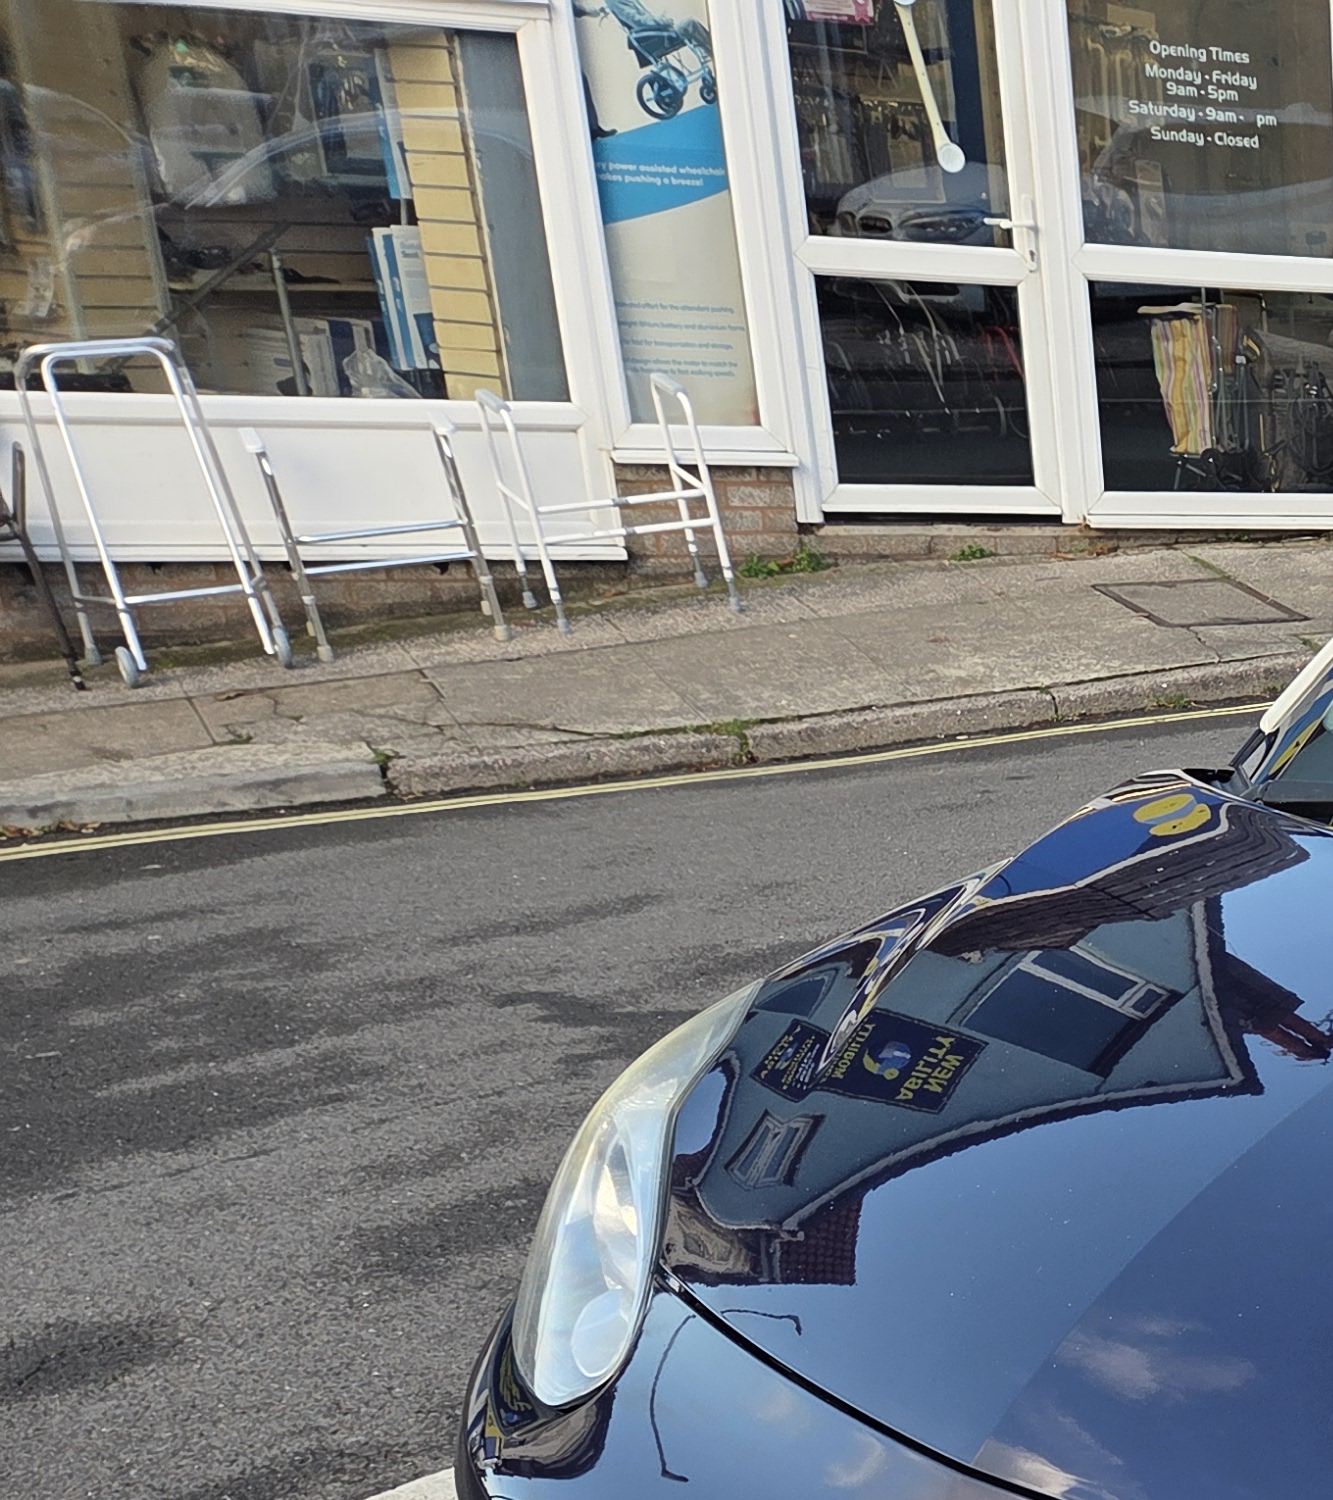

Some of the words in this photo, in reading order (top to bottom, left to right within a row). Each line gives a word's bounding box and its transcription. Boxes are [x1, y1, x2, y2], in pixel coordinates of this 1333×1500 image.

[1150, 40, 1206, 62] Opening
[1209, 47, 1250, 63] Times
[1145, 64, 1201, 84] Monday
[1212, 70, 1257, 90] Friday
[1166, 81, 1197, 97] 9am
[1208, 85, 1239, 102] 5pm
[1128, 100, 1196, 121] Saturday
[1205, 107, 1237, 123] 9am
[1151, 126, 1204, 146] Sunday
[1214, 132, 1260, 148] Closed
[608, 162, 638, 172] power
[639, 163, 678, 174] assisted
[624, 175, 662, 186] pushing
